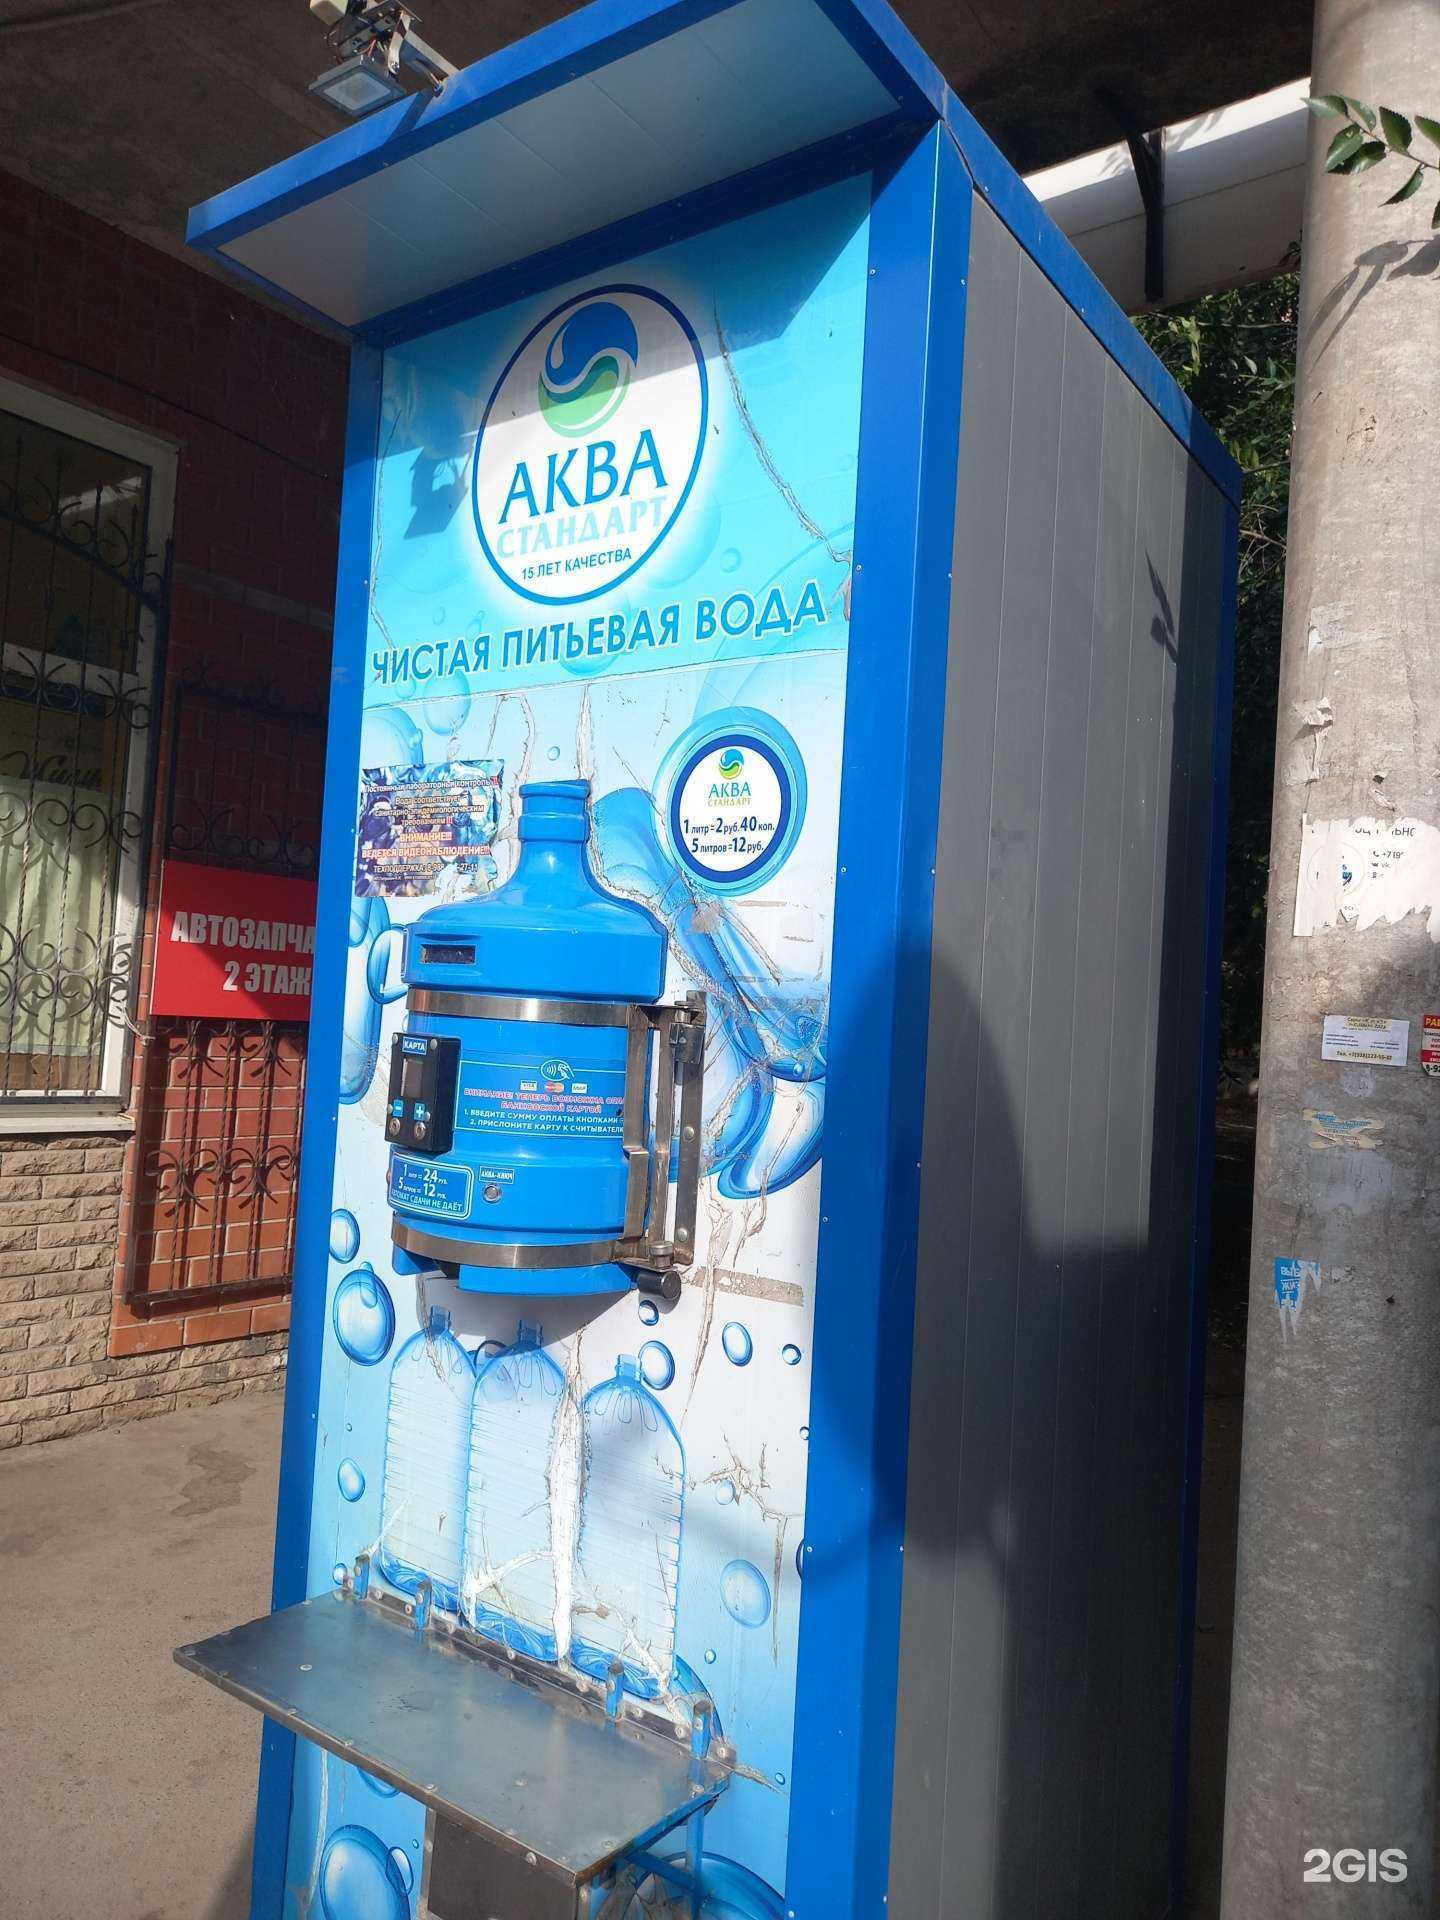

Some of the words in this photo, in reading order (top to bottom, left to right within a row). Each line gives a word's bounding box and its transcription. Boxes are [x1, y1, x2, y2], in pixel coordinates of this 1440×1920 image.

[498, 429, 667, 523] АКВА
[496, 495, 667, 560] СТАНДАРТ
[521, 566, 535, 581] 15
[537, 562, 561, 578] ЛЕТ
[564, 547, 632, 573] КАЧЕСТВА
[373, 637, 490, 685] ЧИСТАЯ
[501, 605, 680, 667] ПИТЬЕВАЯ
[695, 581, 827, 641] ВОДА
[708, 782, 751, 798] АКВА
[707, 797, 751, 807] СТАНДАРТ
[684, 819, 689, 834] 1
[740, 816, 757, 831] 40
[758, 822, 775, 831] коп.
[691, 838, 699, 853] 5
[747, 840, 764, 854] руб.
[222, 960, 238, 991] 2
[244, 963, 312, 996] ЭТАЖ
[403, 1040, 426, 1052] КАРТА
[470, 1109, 505, 1118] ВВЕДИТЕ
[507, 1112, 537, 1120] СУММУ
[477, 1119, 532, 1129] ПРИСЛОНИТЕ
[398, 1177, 404, 1189] 5
[423, 1183, 436, 1197] 12
[410, 1194, 431, 1206] СДАЧИ
[431, 1198, 441, 1208] НЕ
